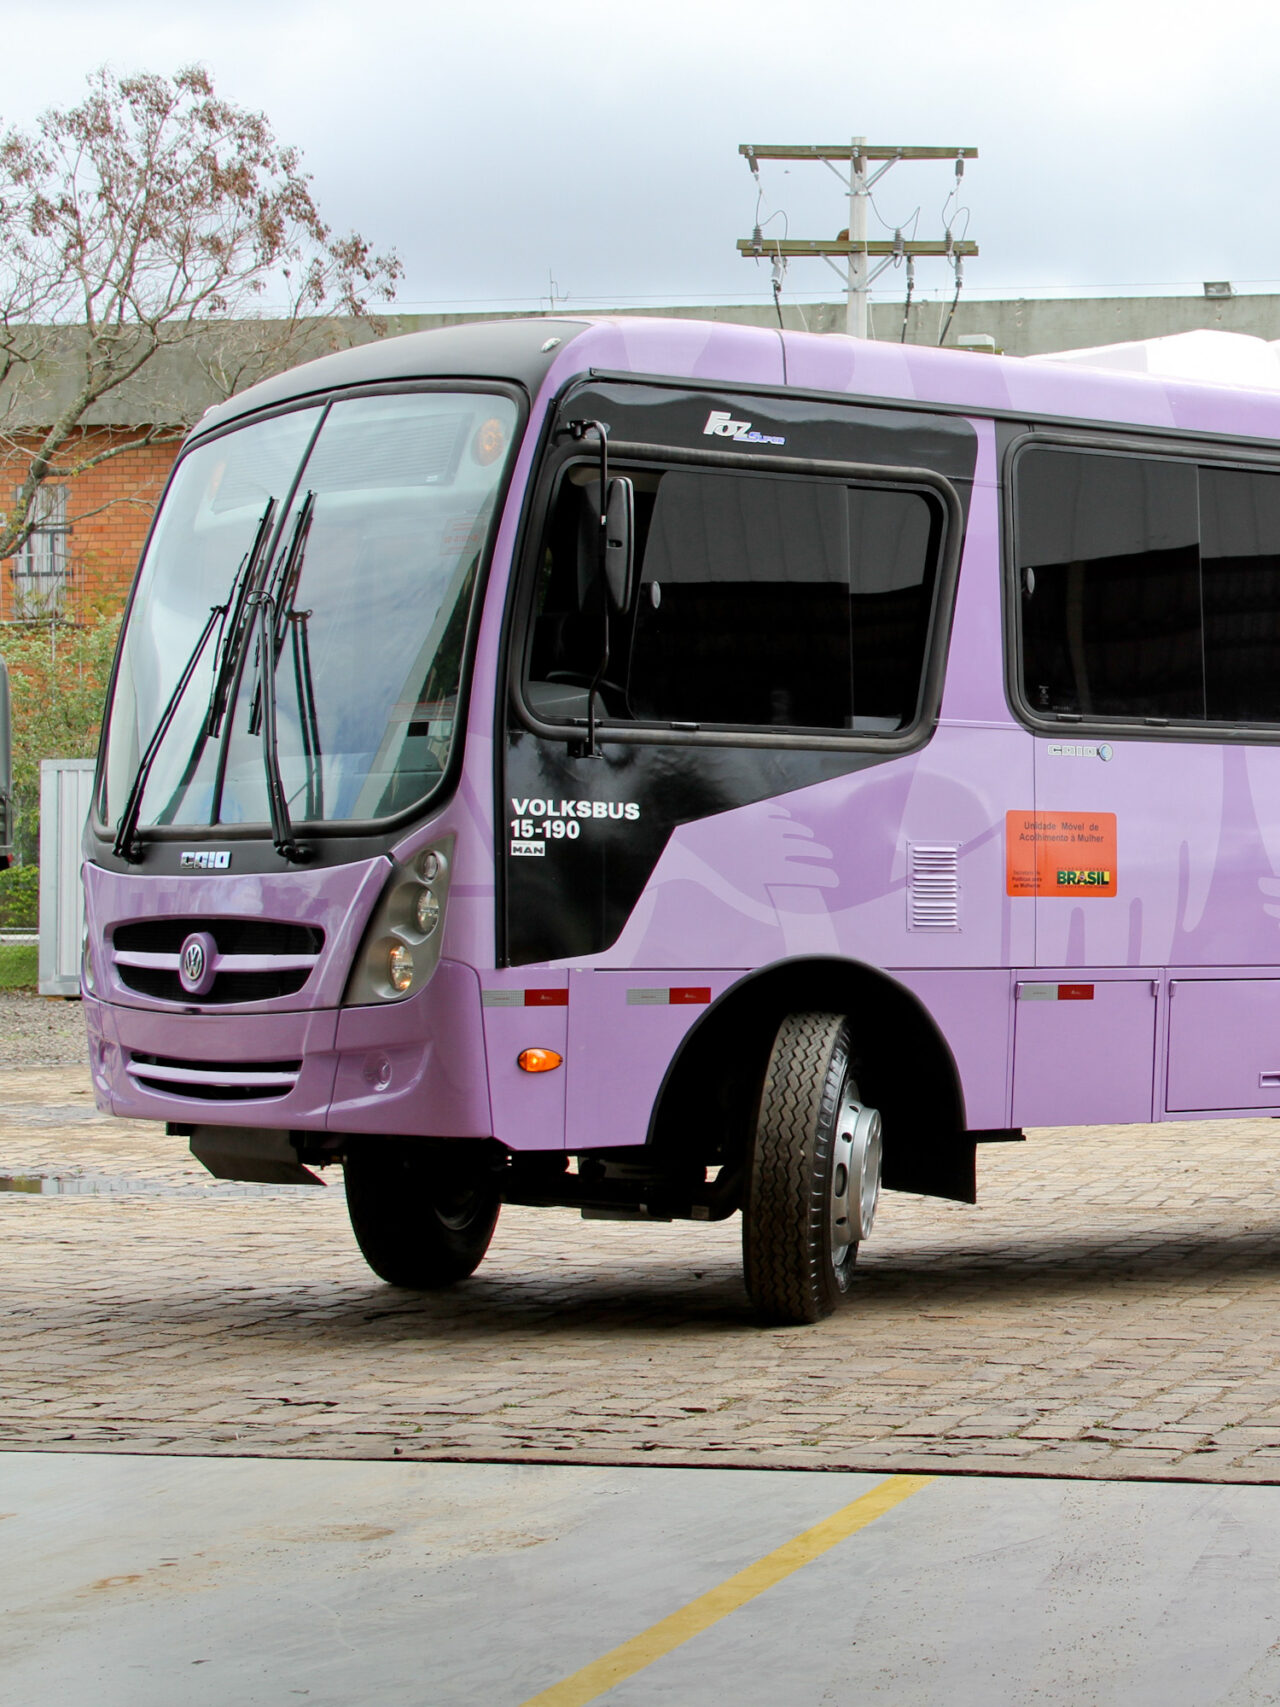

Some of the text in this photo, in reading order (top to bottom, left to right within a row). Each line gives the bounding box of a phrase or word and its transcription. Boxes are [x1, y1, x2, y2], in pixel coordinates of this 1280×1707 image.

[511, 798, 641, 820] VOLKSBUS
[510, 819, 580, 839] 15-190
[1024, 821, 1057, 831] Unidade
[1089, 823, 1099, 832] de
[1019, 832, 1068, 842] Acolhimento
[1077, 834, 1104, 843] Mulher
[512, 845, 544, 855] MAN
[1057, 870, 1110, 885] BRASIL
